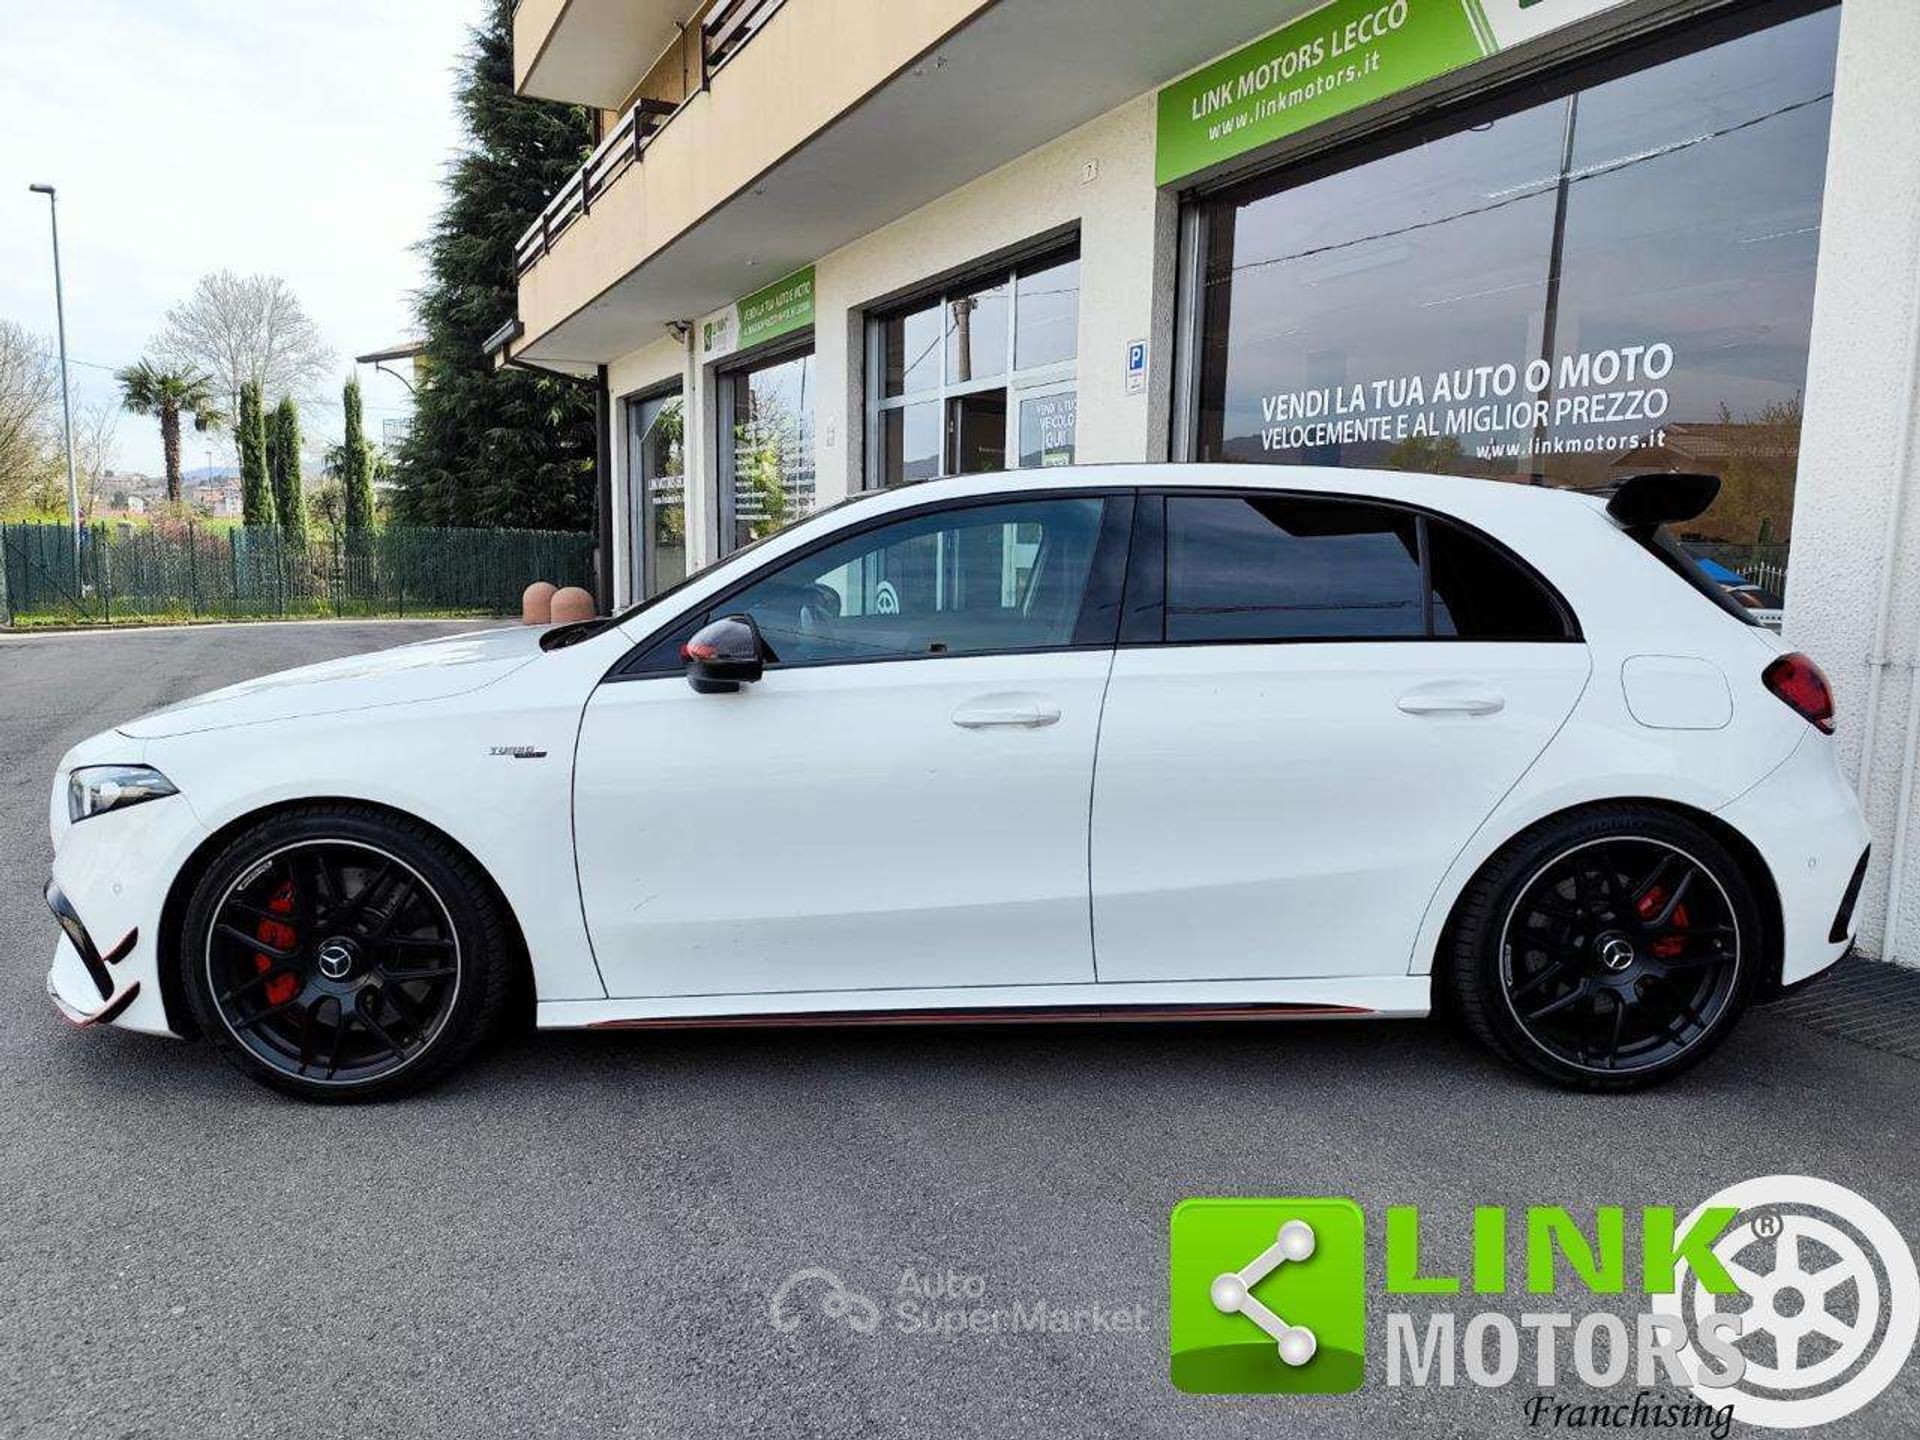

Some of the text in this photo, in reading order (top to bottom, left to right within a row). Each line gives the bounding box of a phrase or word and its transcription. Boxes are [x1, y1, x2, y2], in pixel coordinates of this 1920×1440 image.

[1191, 0, 1409, 120] LINK MOTORS LECCO
[1208, 50, 1381, 141] www.linkmotors.it
[1131, 347, 1141, 369] P
[1262, 342, 1675, 424] VENDI LA TUA AUTO O MOTO
[1261, 388, 1670, 451] VELOCEMENTE E AL MIGLIOR PREZZO
[1476, 430, 1667, 461] www.linkmotors.it
